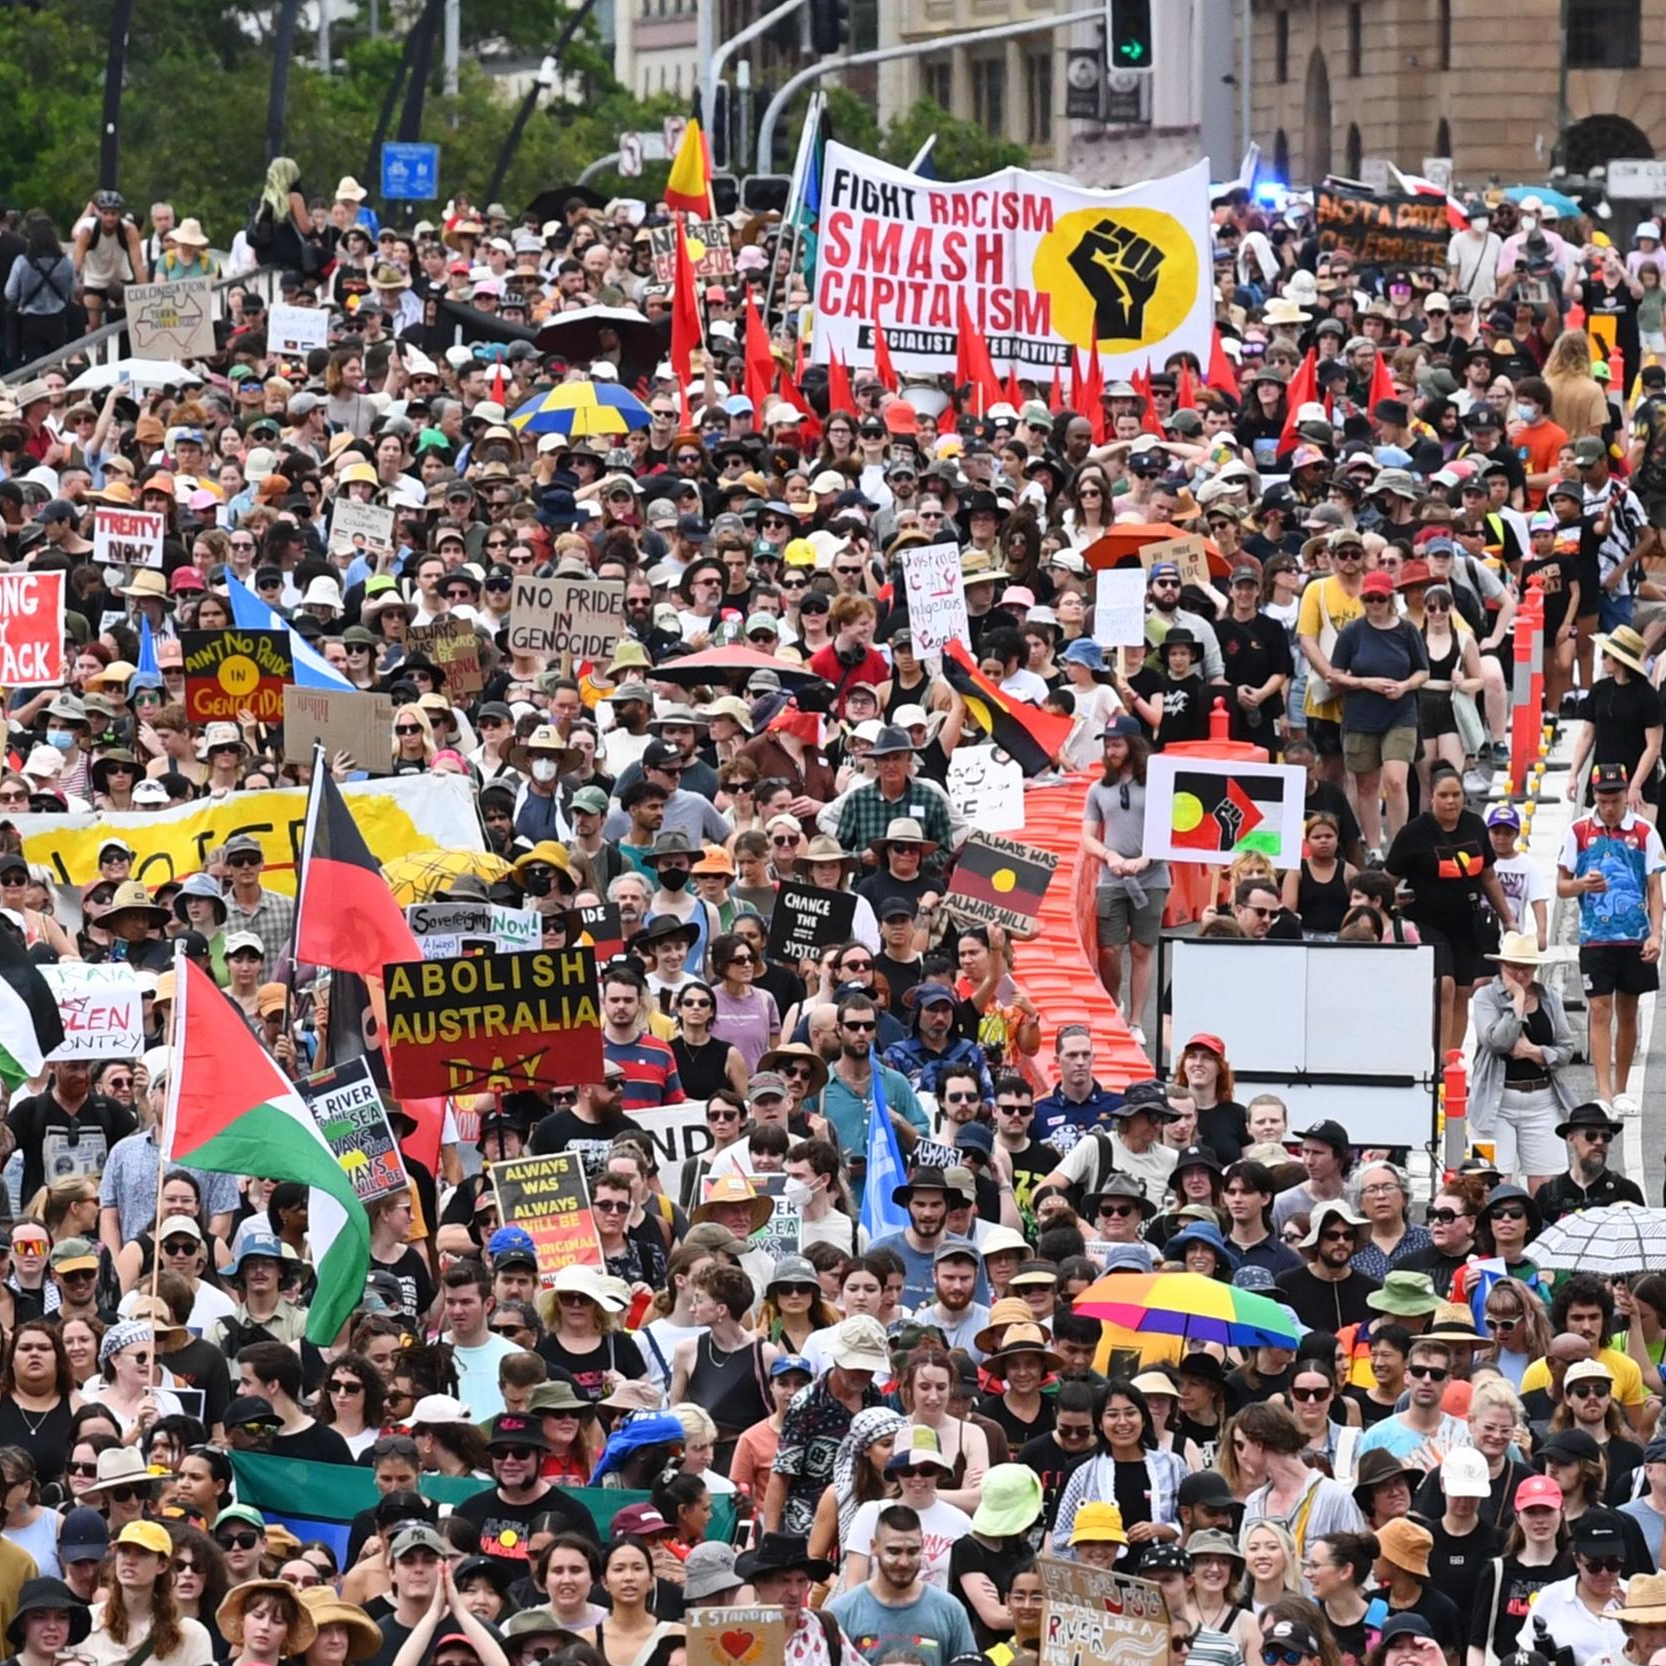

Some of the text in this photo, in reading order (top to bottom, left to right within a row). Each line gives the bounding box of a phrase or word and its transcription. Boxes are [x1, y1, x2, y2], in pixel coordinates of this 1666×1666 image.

[832, 169, 1052, 233] FIGHT RACISM
[825, 212, 1002, 286] SMASH
[128, 282, 207, 302] COLONISATION
[96, 511, 160, 538] TREATY
[516, 586, 623, 614] NO PRIDE
[553, 612, 573, 631] IN
[513, 627, 616, 659] GENOCIDE
[971, 830, 1059, 869] ALWAYS WAS
[946, 894, 998, 920] ALWAYS
[797, 914, 818, 929] THE
[388, 953, 585, 1000] ABOLISH
[389, 995, 599, 1047] AUSTRALIA
[448, 1052, 542, 1091] DAY
[505, 1160, 569, 1181] ALWAYS
[521, 1178, 559, 1196] WAS
[513, 1199, 578, 1219] ALWAYS
